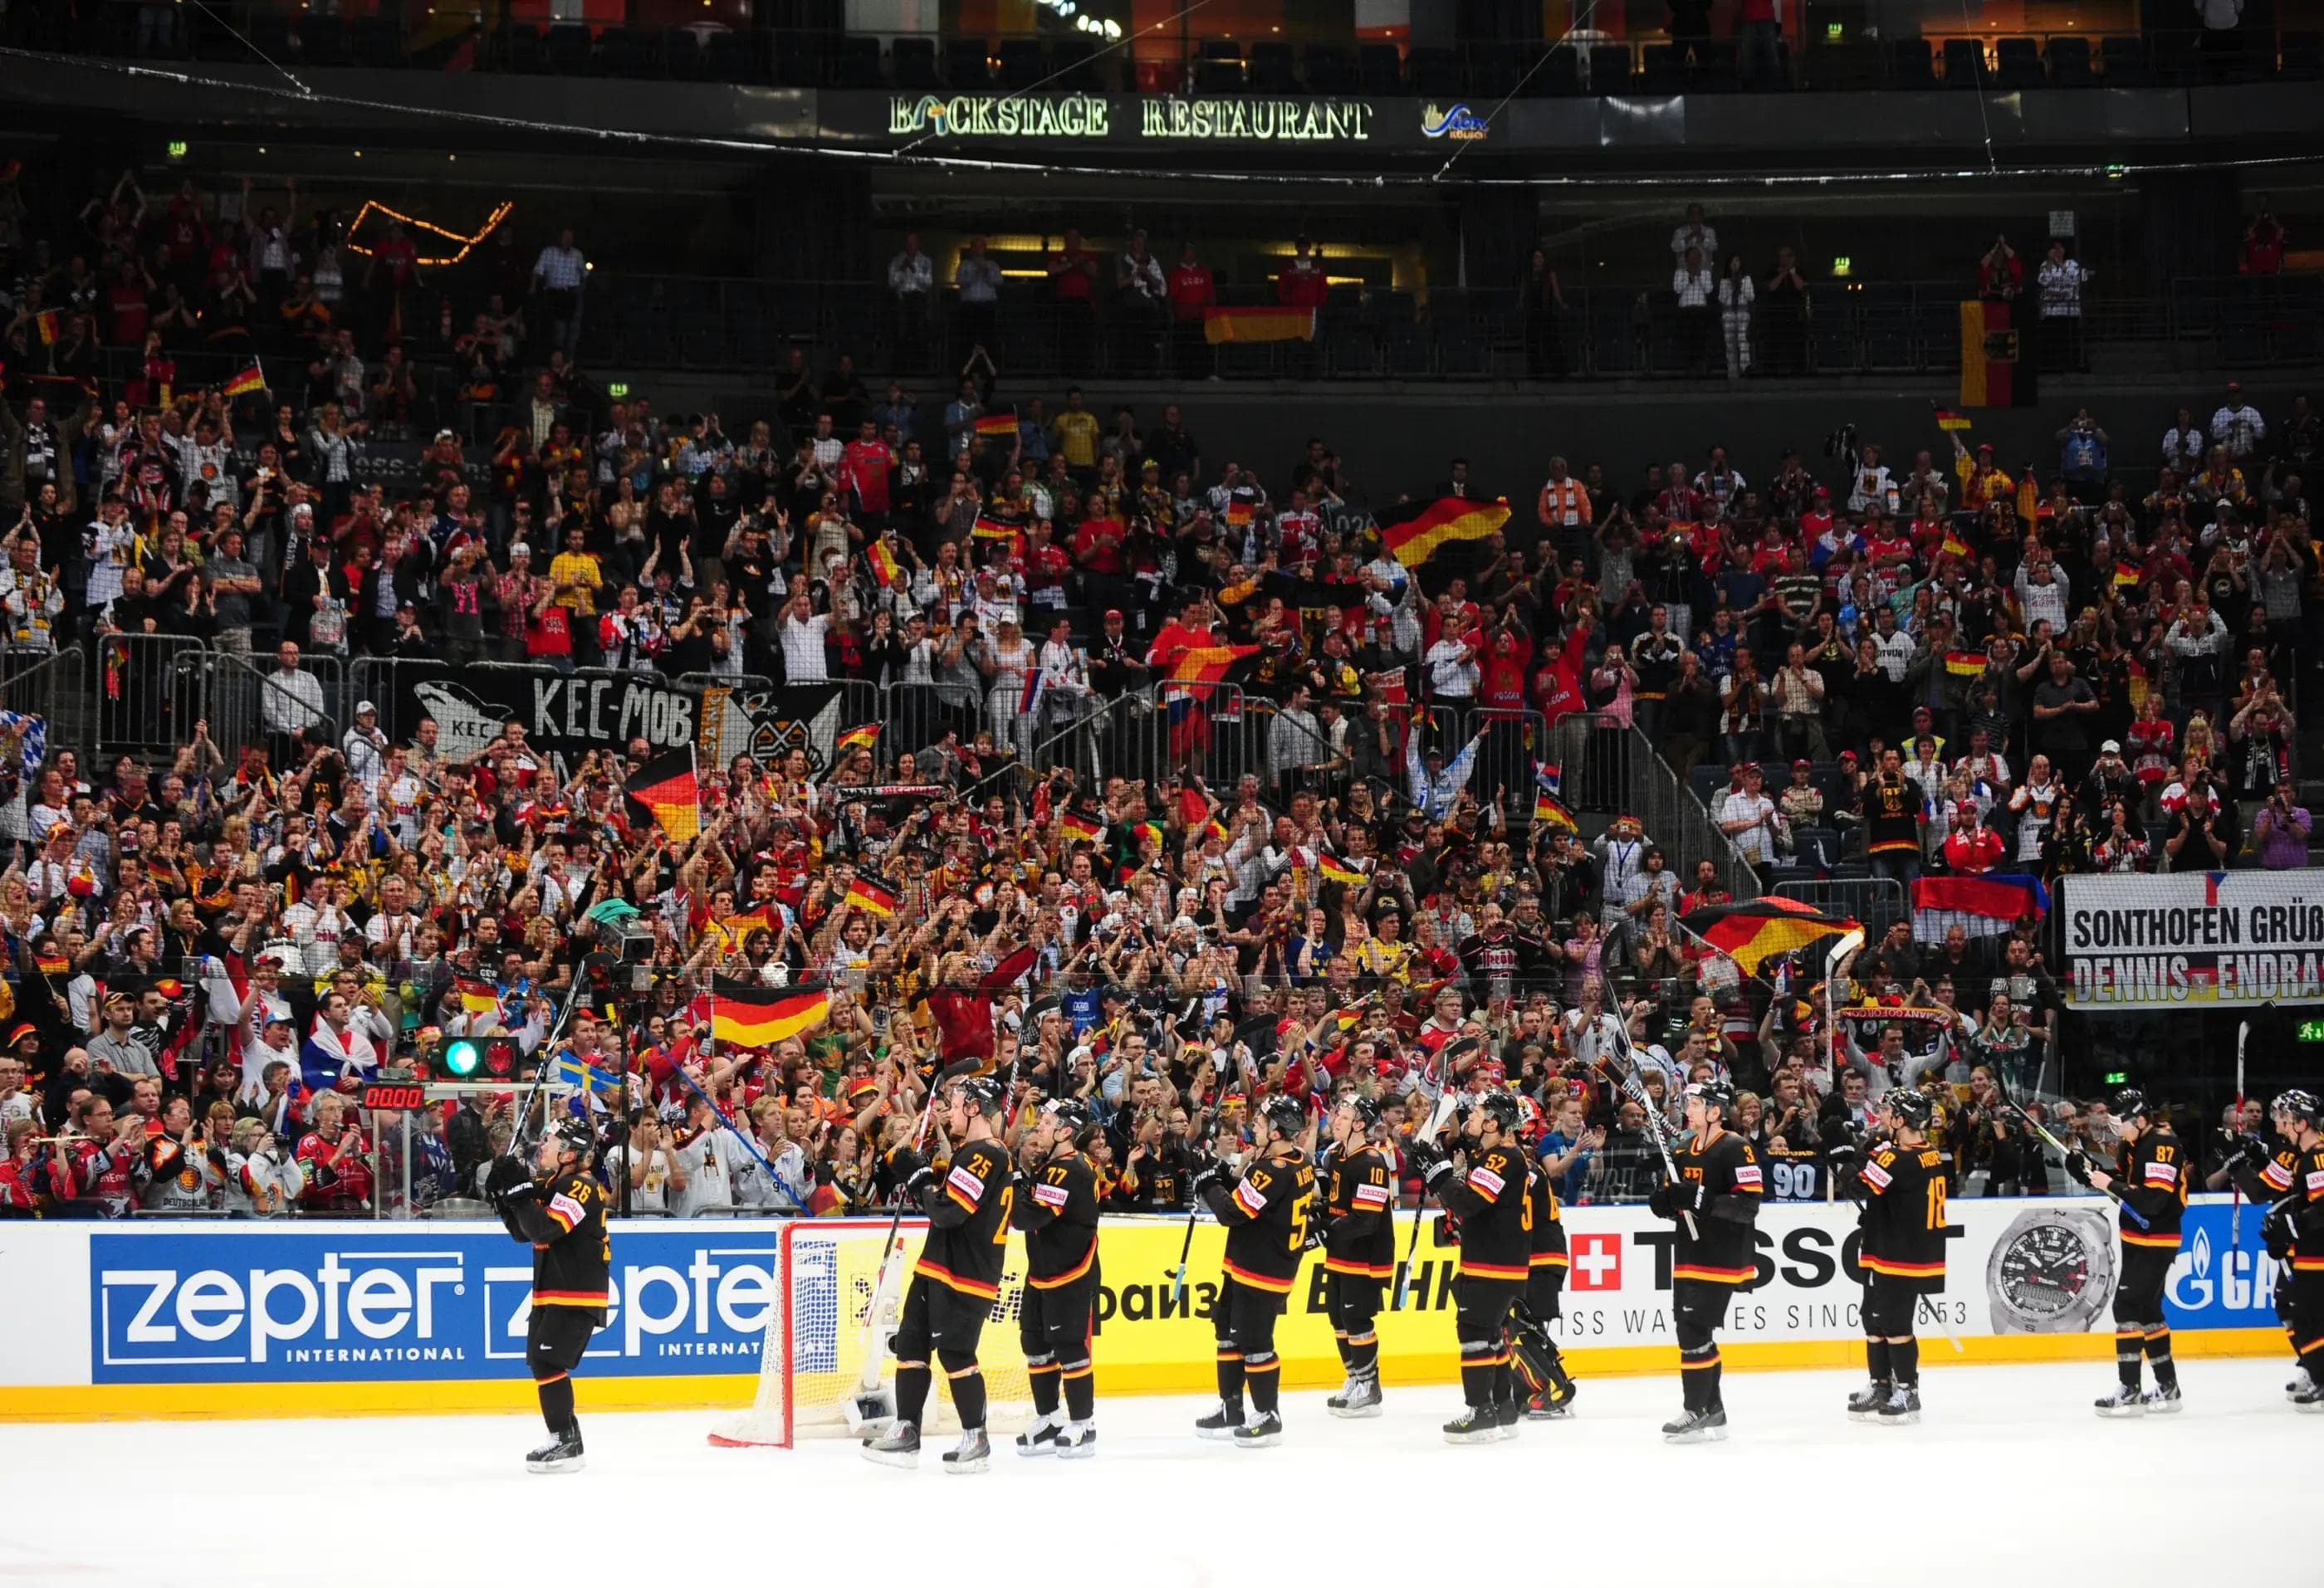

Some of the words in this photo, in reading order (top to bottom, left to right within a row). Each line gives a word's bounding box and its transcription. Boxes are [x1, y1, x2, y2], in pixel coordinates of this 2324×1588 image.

[888, 95, 1108, 136] BACKSTAGE
[1141, 99, 1372, 139] RESTAURANT
[534, 678, 692, 747] KEC-MOB
[451, 719, 489, 739] KEC
[2073, 906, 2240, 948] SONTHOFEN
[2073, 955, 2189, 1003] DENNIS
[2217, 952, 2324, 1000] ENDRA
[966, 1153, 993, 1180] 25
[1485, 1154, 1507, 1175] 52
[1743, 1146, 1755, 1163] 3
[1876, 1150, 1896, 1169] 18
[2156, 1145, 2175, 1163] 87
[1047, 1166, 1068, 1186] 77
[1250, 1170, 1273, 1191] 57
[1370, 1167, 1384, 1185] 10
[1773, 1163, 1816, 1198] 90
[567, 1180, 592, 1204] 26
[1926, 1175, 1947, 1230] 18
[993, 1185, 1013, 1244] 2
[1288, 1191, 1313, 1252] 5
[102, 1252, 463, 1362] zepter
[1787, 1302, 1860, 1328] SINC
[1918, 1302, 1966, 1326] 853
[286, 1346, 465, 1363] INTERNATIONAL
